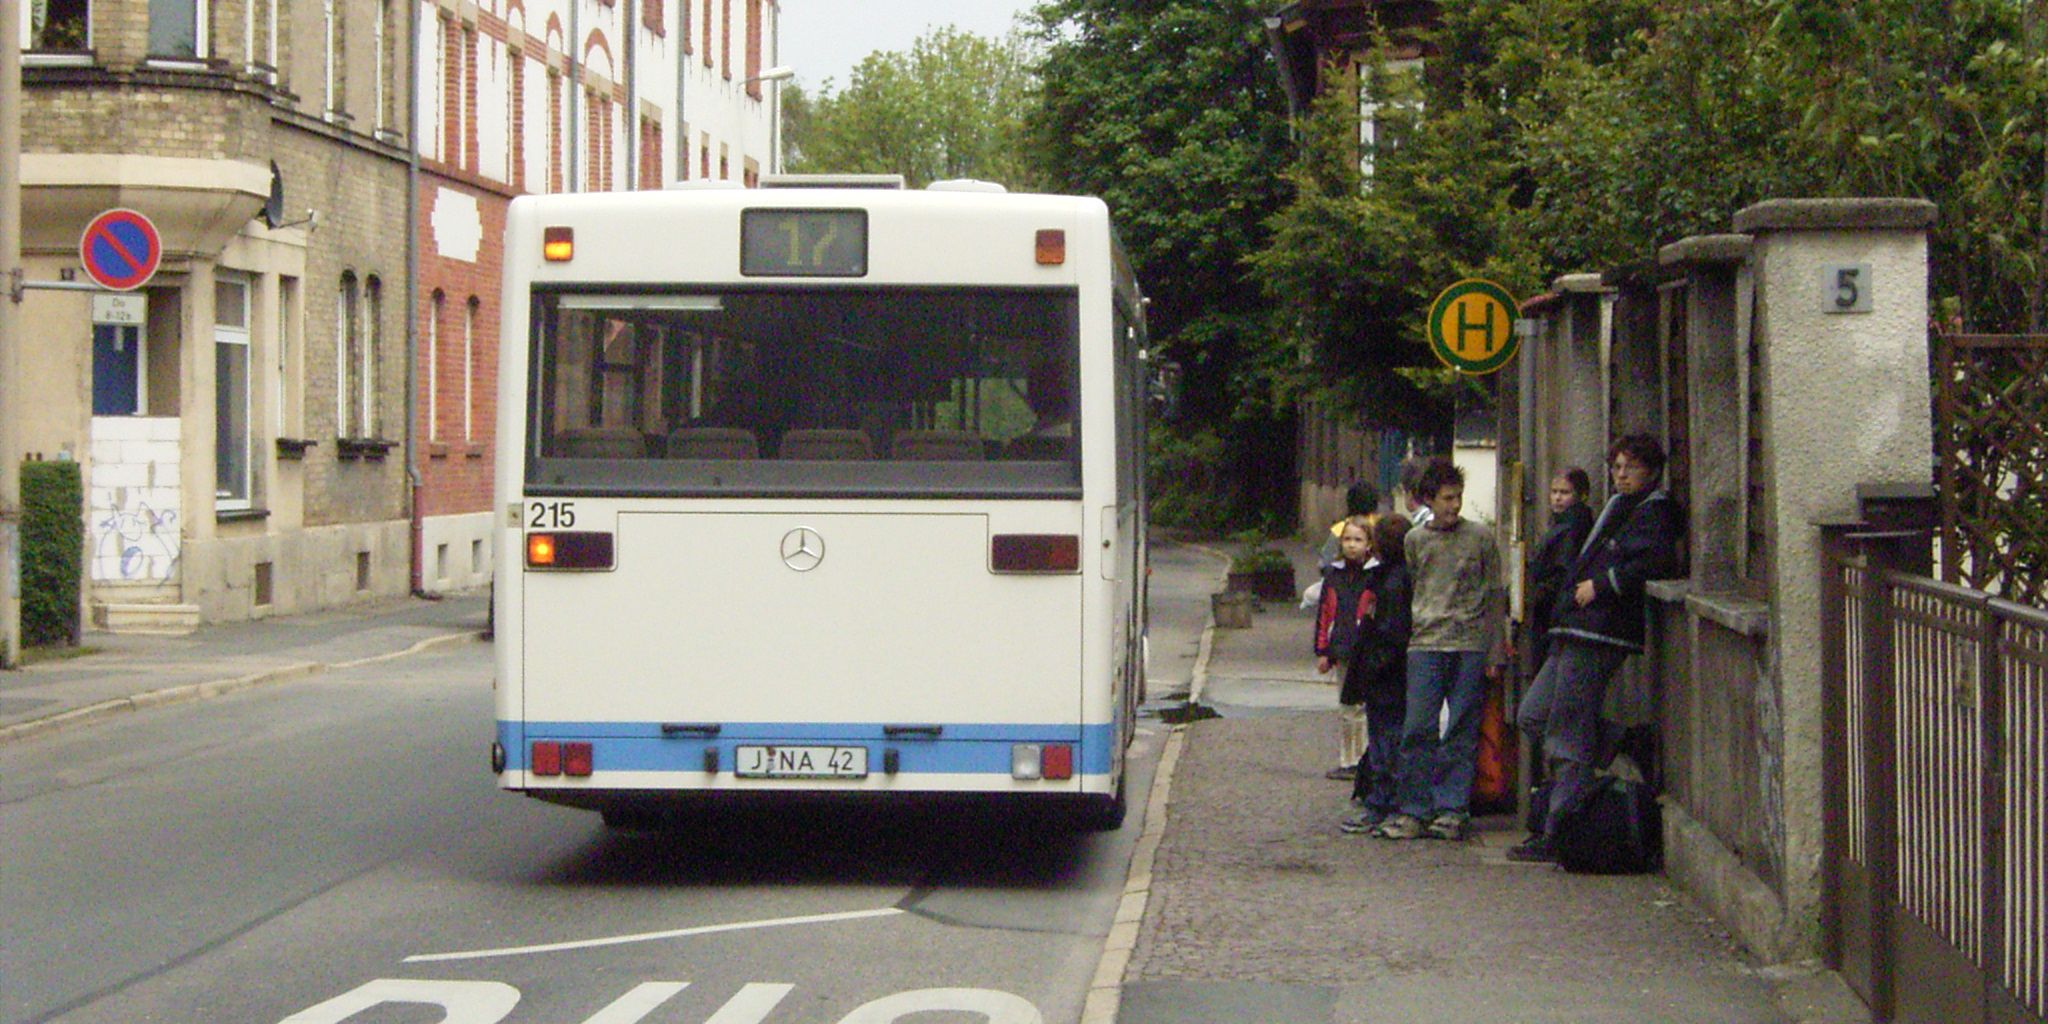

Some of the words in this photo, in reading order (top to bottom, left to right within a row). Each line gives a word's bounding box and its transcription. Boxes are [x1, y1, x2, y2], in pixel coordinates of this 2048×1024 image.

[779, 217, 838, 265] 17
[1835, 268, 1859, 307] 5
[1457, 301, 1494, 352] H
[530, 502, 576, 528] 215
[828, 748, 853, 774] 42
